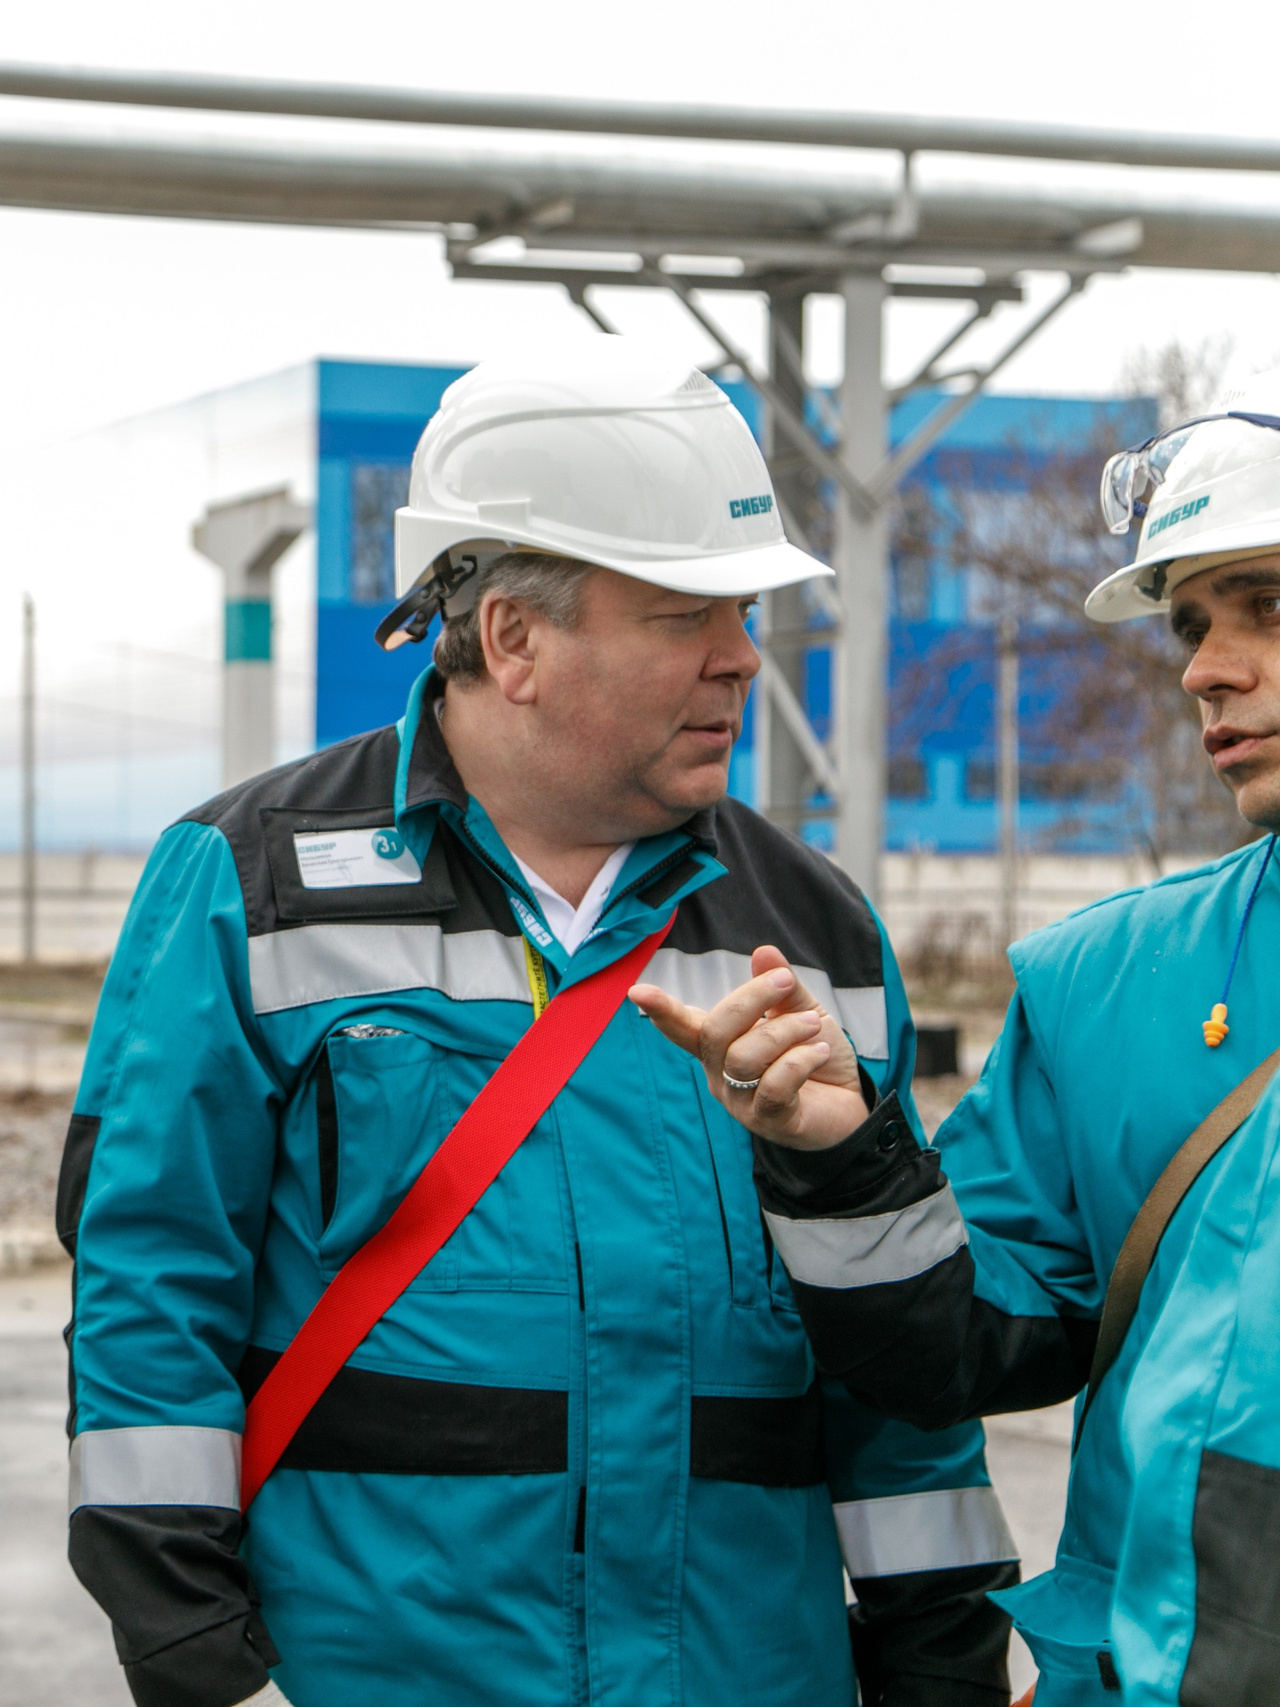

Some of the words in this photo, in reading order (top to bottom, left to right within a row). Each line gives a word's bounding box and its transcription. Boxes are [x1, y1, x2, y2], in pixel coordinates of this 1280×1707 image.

[729, 494, 773, 519] СИБУР
[1147, 495, 1210, 540] СИБУР
[297, 842, 336, 854] СИБУР
[510, 896, 553, 948] СИБУР
